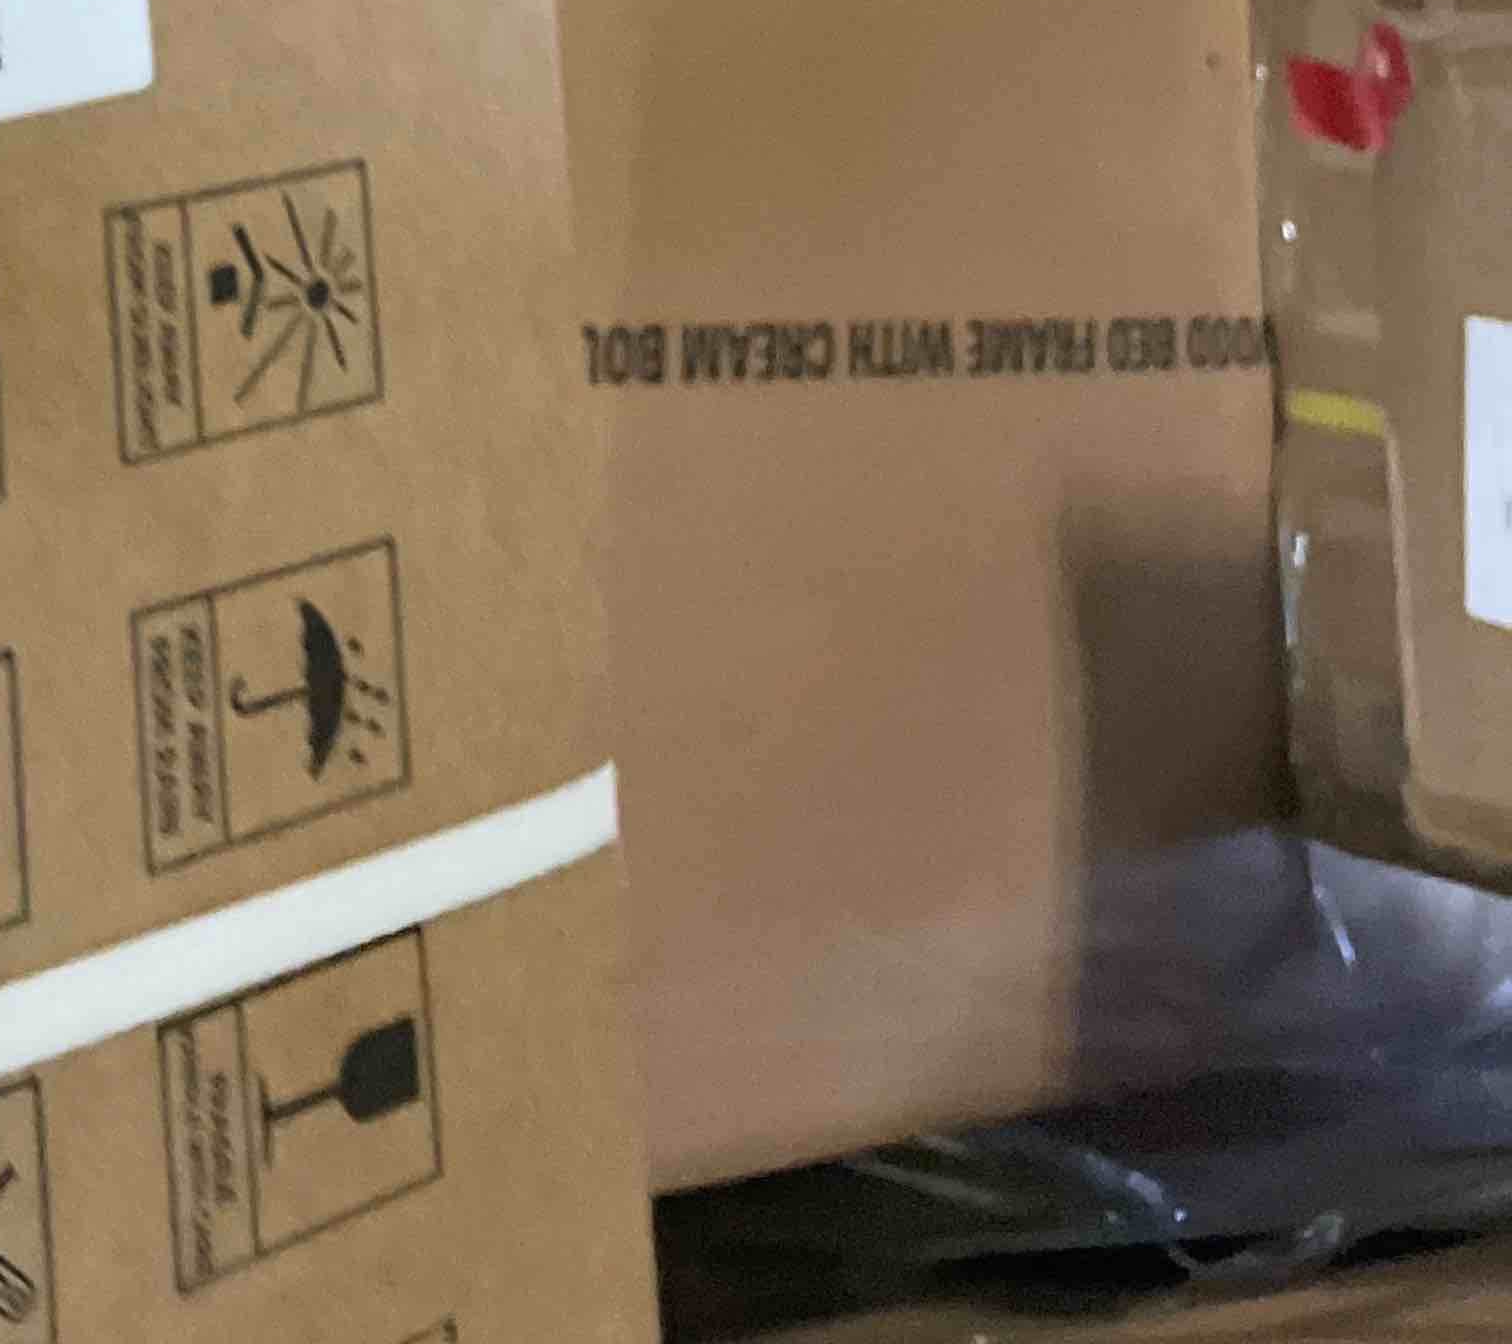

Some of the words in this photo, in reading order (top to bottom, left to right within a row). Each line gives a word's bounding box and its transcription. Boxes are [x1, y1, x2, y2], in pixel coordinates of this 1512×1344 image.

[681, 322, 836, 386] CREAM
[846, 318, 955, 379] WITH
[965, 318, 1096, 377] FRAME
